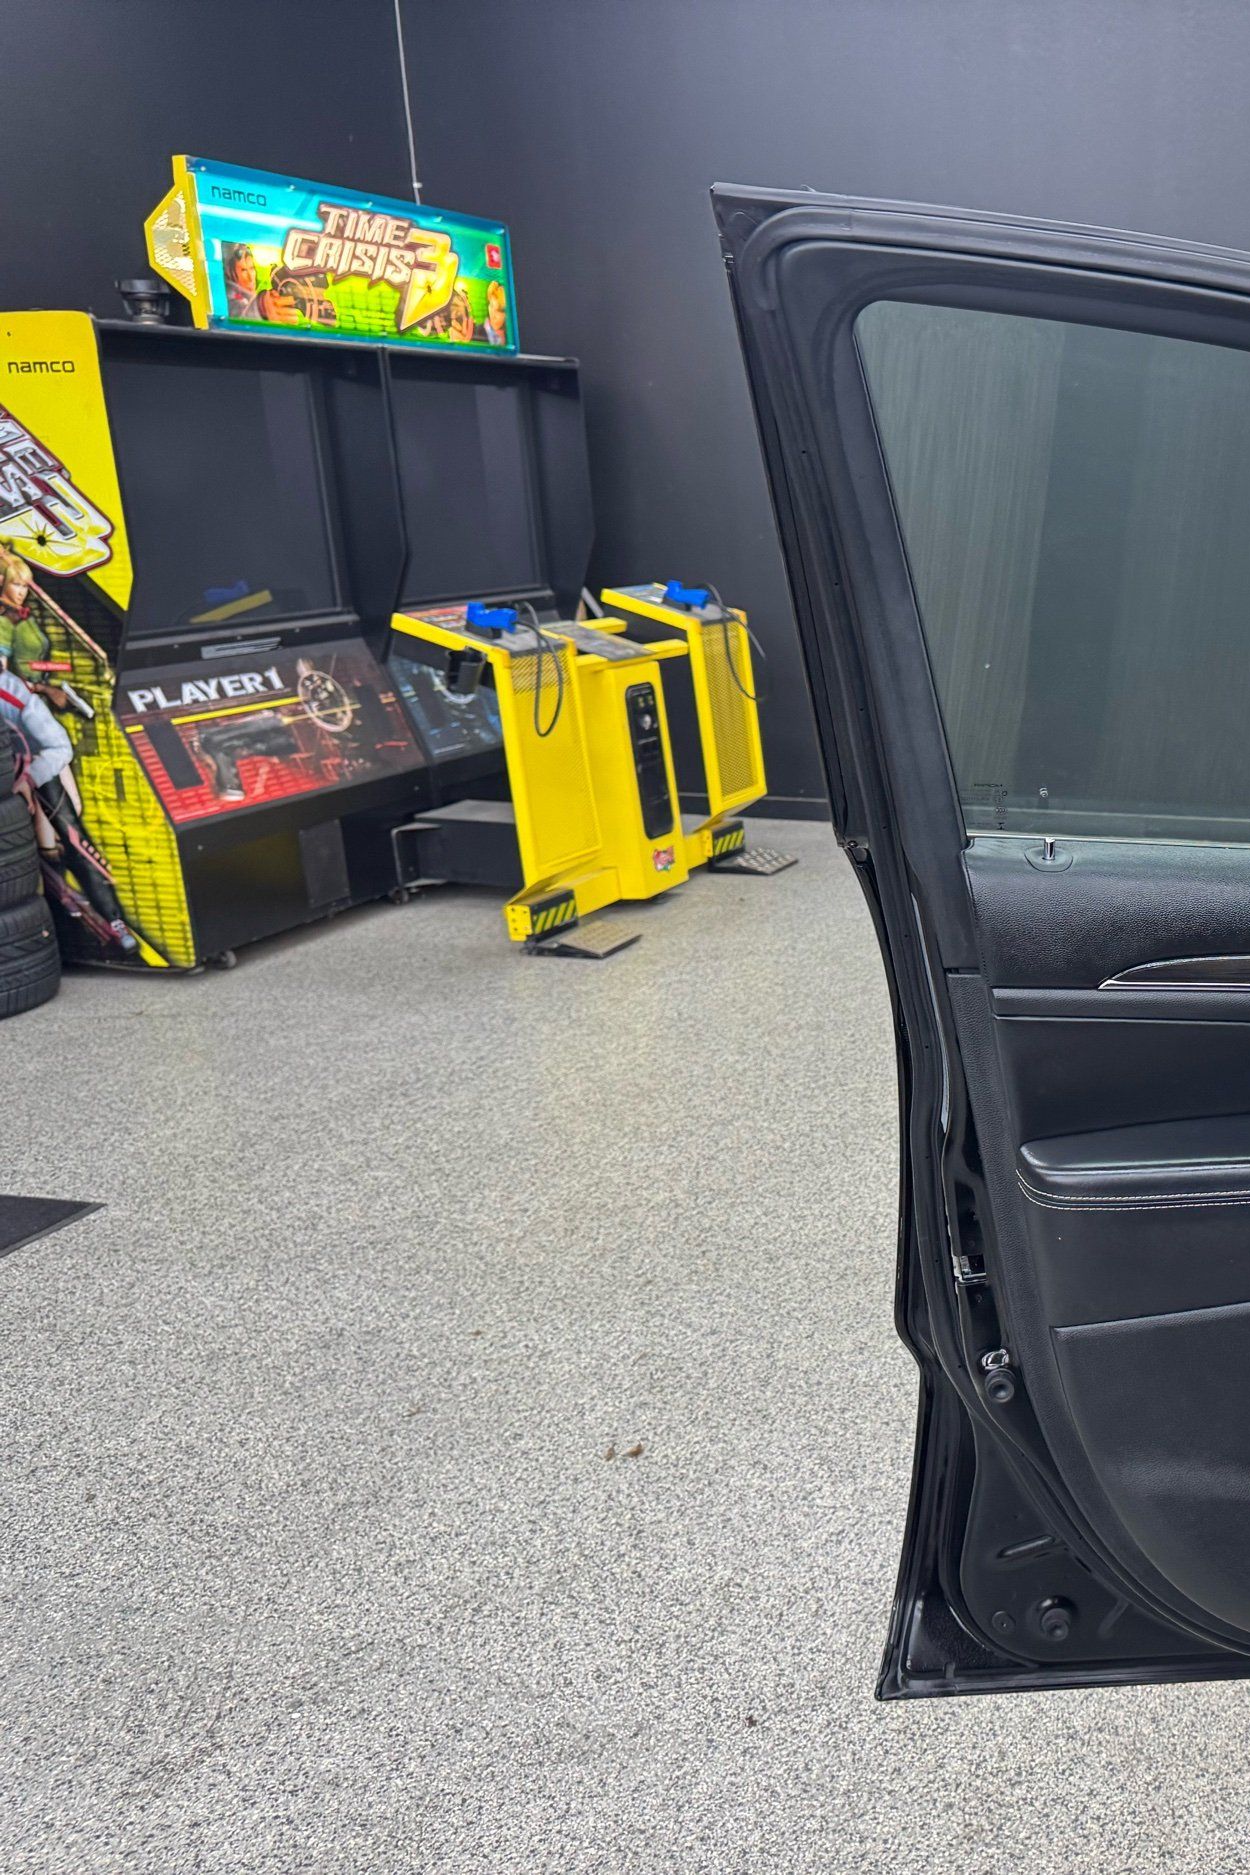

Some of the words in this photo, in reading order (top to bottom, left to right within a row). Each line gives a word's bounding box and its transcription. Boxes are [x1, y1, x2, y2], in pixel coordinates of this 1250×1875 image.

[211, 185, 267, 207] namco
[319, 204, 411, 246] TIME
[282, 229, 416, 285] CRISIS
[400, 227, 459, 331] 3
[7, 360, 75, 374] namco
